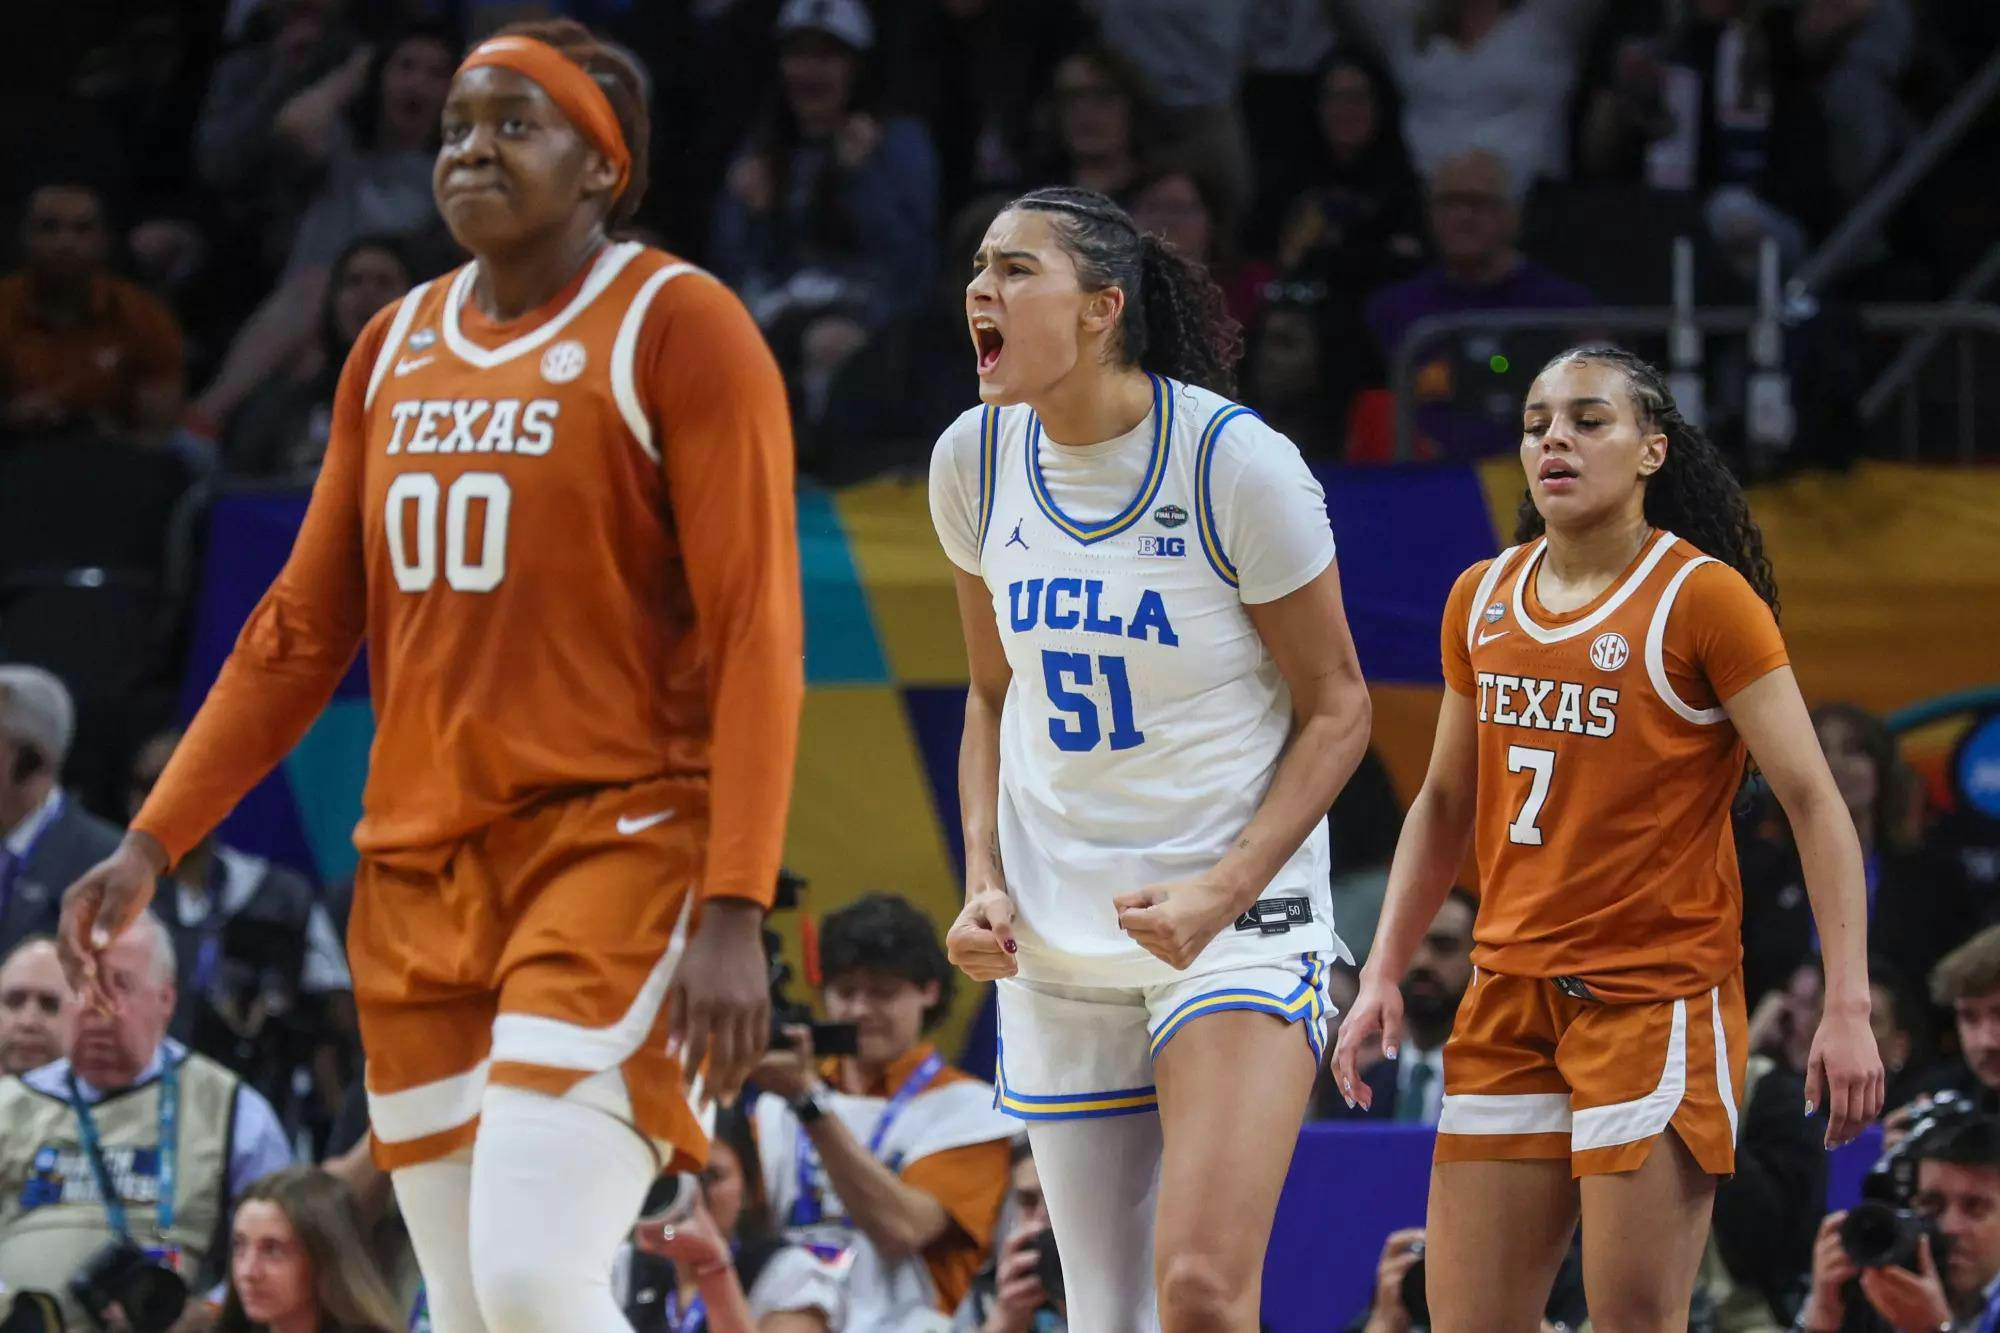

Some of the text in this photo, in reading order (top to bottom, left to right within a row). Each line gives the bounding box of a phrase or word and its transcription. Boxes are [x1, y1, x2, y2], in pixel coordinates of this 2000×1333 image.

[386, 398, 560, 456] TEXAS
[384, 471, 512, 592] 00
[1008, 577, 1179, 648] UCLA
[1592, 634, 1627, 670] SEC
[1040, 649, 1146, 752] 51
[1477, 672, 1619, 738] TEXAS
[1507, 744, 1556, 845] 7
[1288, 905, 1300, 916] 50
